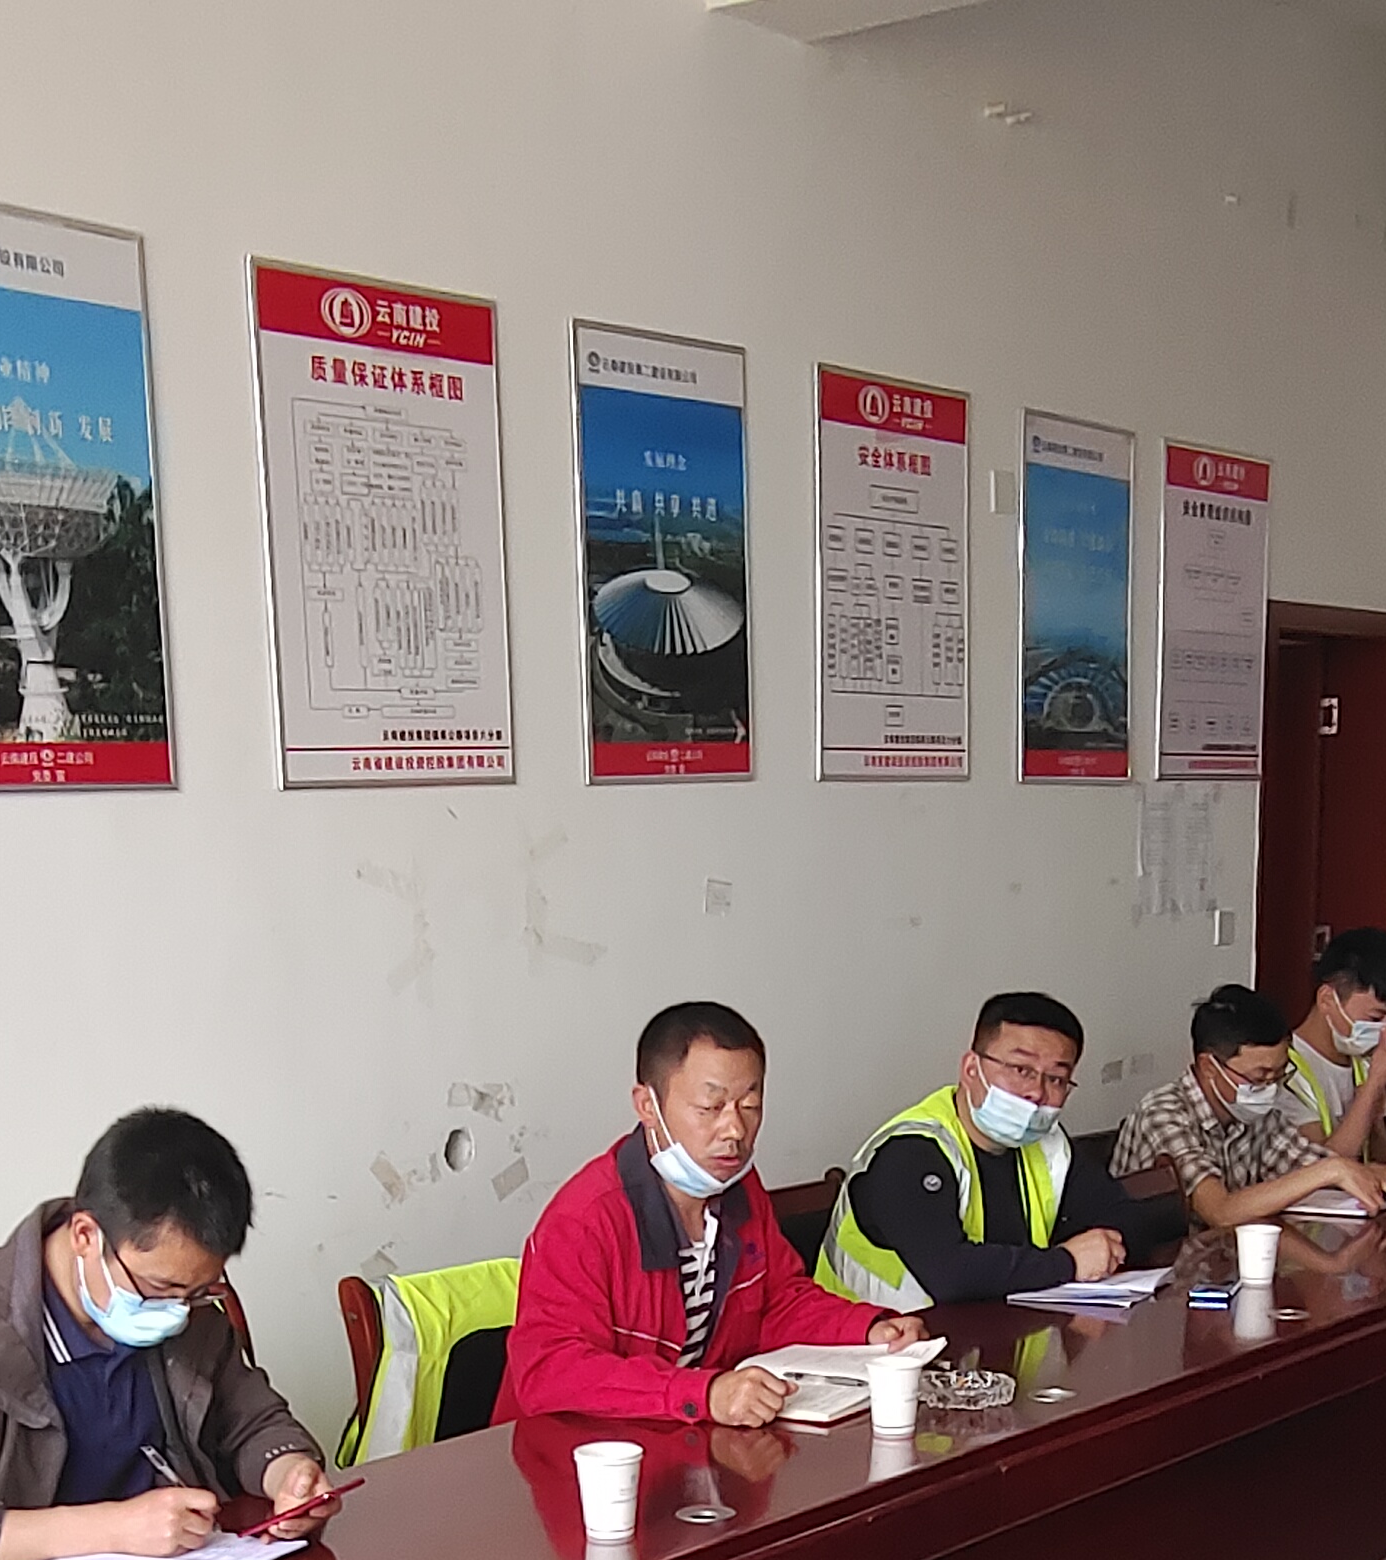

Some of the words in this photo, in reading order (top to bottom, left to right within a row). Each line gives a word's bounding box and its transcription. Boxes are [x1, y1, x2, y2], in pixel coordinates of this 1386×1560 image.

[375, 299, 441, 333] 云南建投
[310, 355, 465, 401] 质量保证体系框图
[78, 414, 114, 442] 发展
